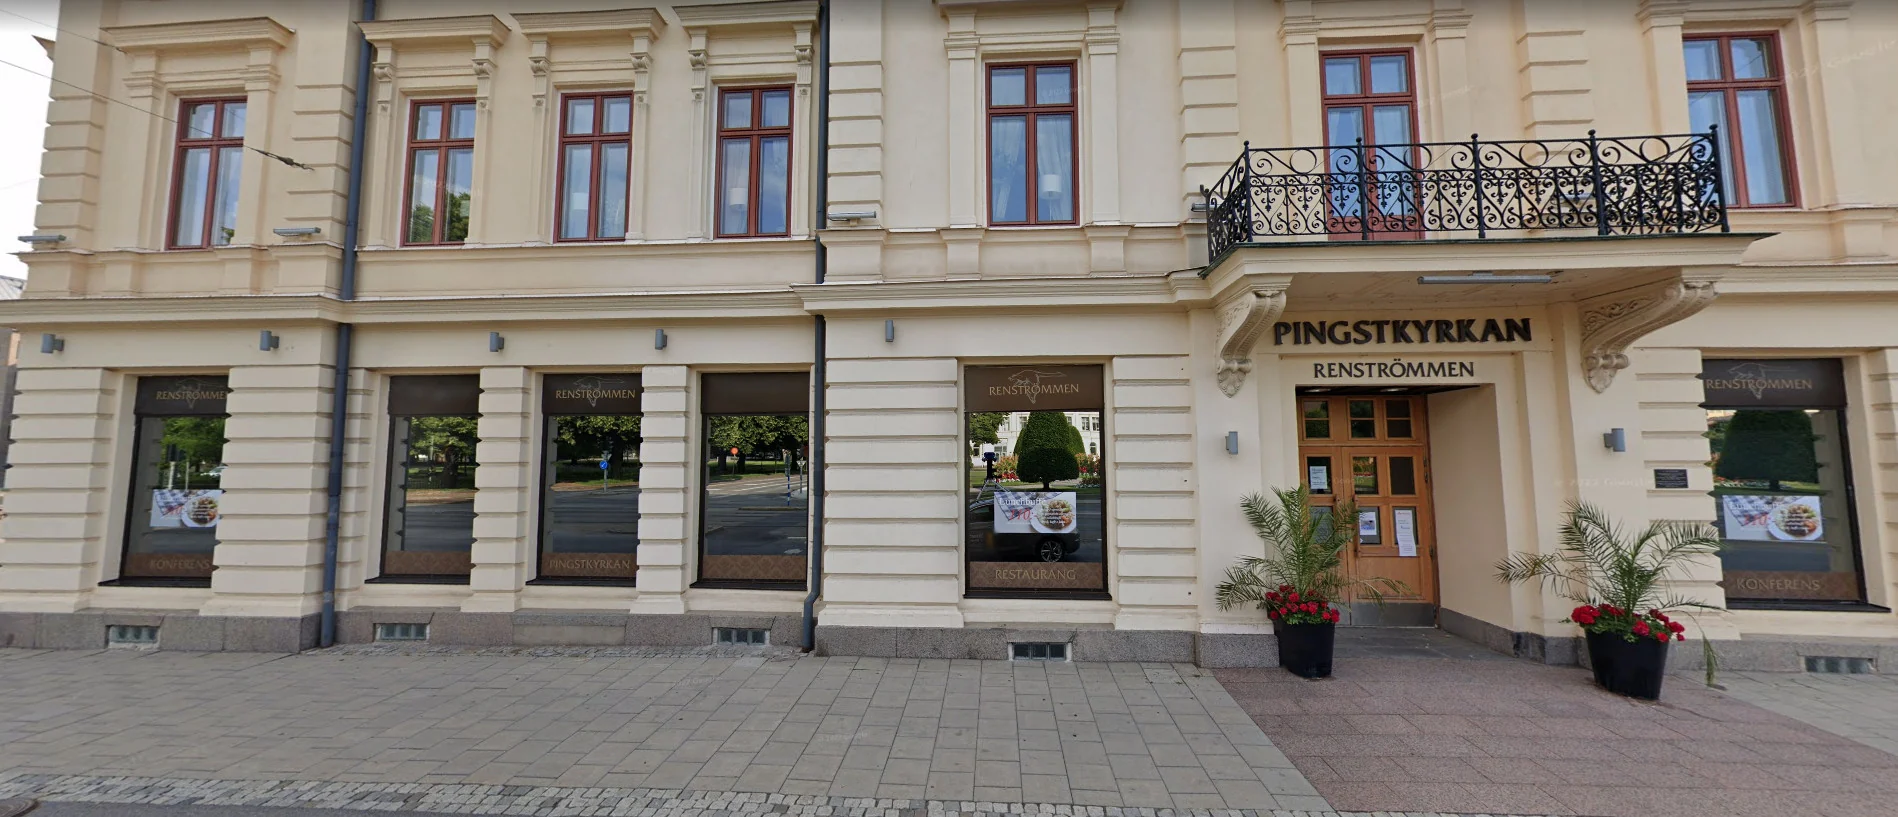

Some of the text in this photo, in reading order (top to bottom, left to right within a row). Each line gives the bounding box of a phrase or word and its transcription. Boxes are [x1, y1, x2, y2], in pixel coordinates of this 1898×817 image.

[1273, 317, 1532, 346] PINGSTKYRKAN
[1313, 357, 1475, 379] RENSTRÖMMEN
[156, 389, 227, 400] RENSTRÖMME
[989, 382, 1080, 396] RENSTRÖMMEN
[149, 558, 210, 570] KONFERENS
[549, 558, 631, 569] PINGSTKYRKAN
[995, 568, 1077, 581] RESTAURANG
[1736, 577, 1821, 591] KONFERENS
